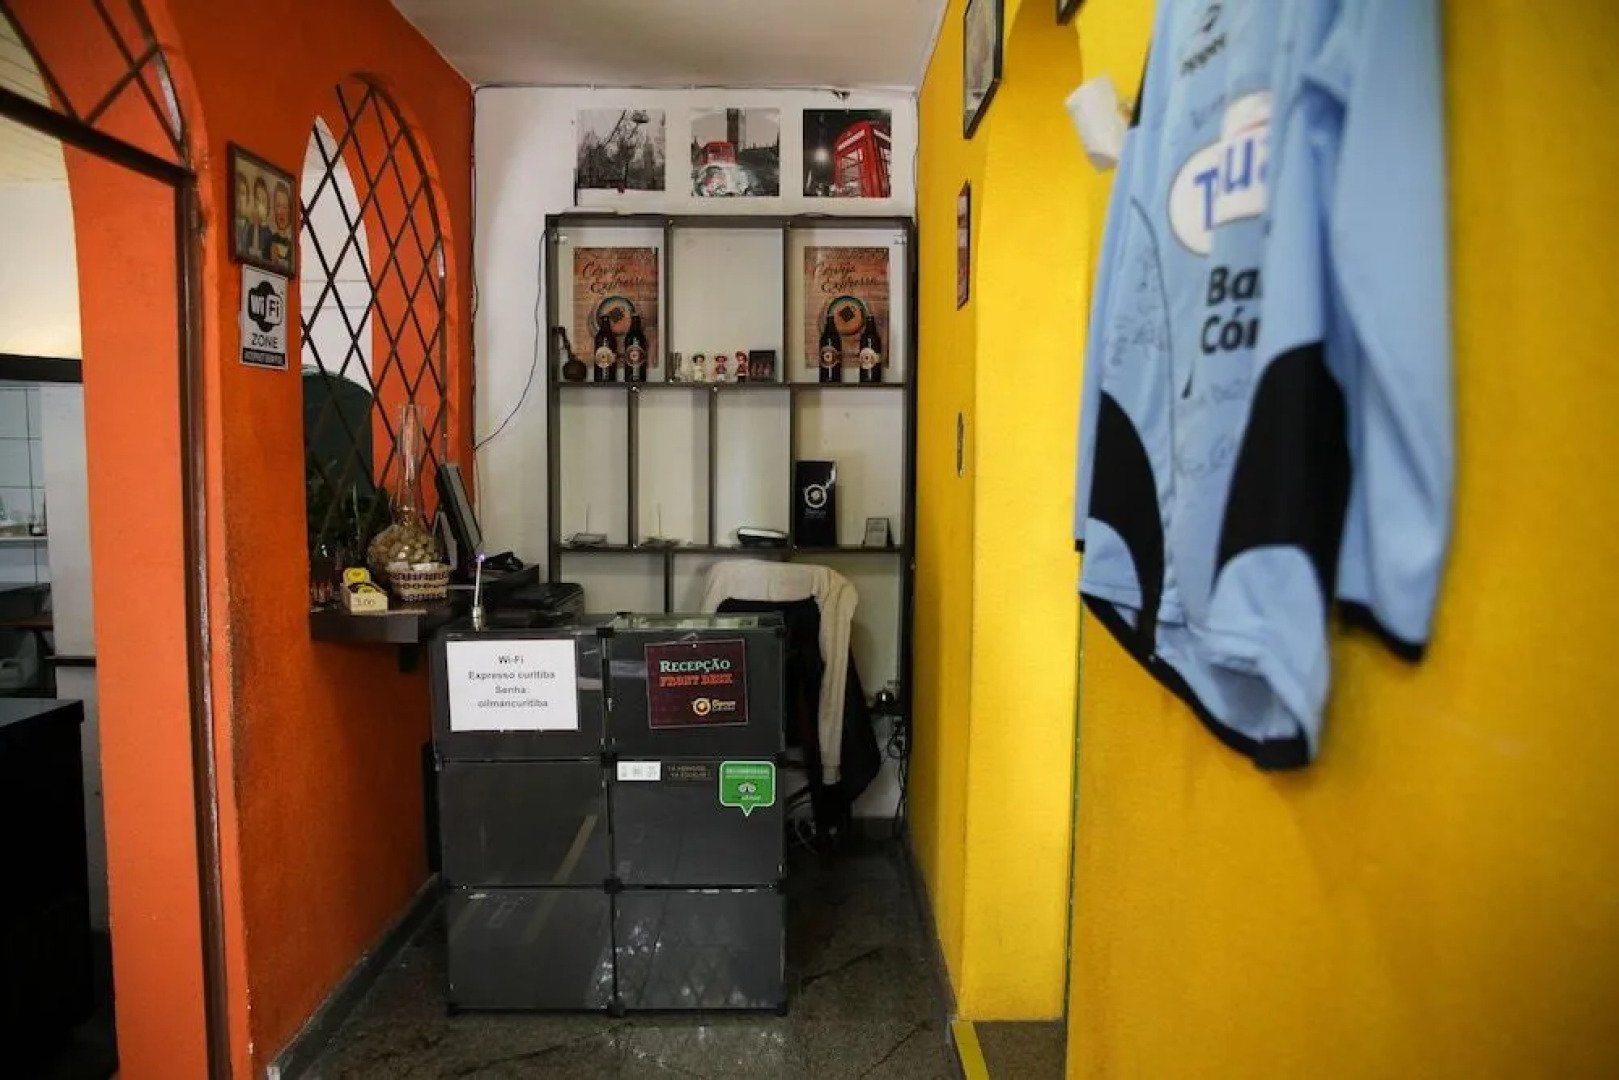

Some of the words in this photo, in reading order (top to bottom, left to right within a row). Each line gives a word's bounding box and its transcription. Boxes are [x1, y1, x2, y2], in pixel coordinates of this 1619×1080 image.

[1207, 266, 1264, 306] Ba
[251, 333, 279, 349] ZONE
[498, 655, 524, 664] Wi-Fi
[468, 671, 516, 680] Expresso
[517, 670, 556, 679] curitiba
[659, 674, 700, 687] FRONT
[700, 673, 733, 685] DESK
